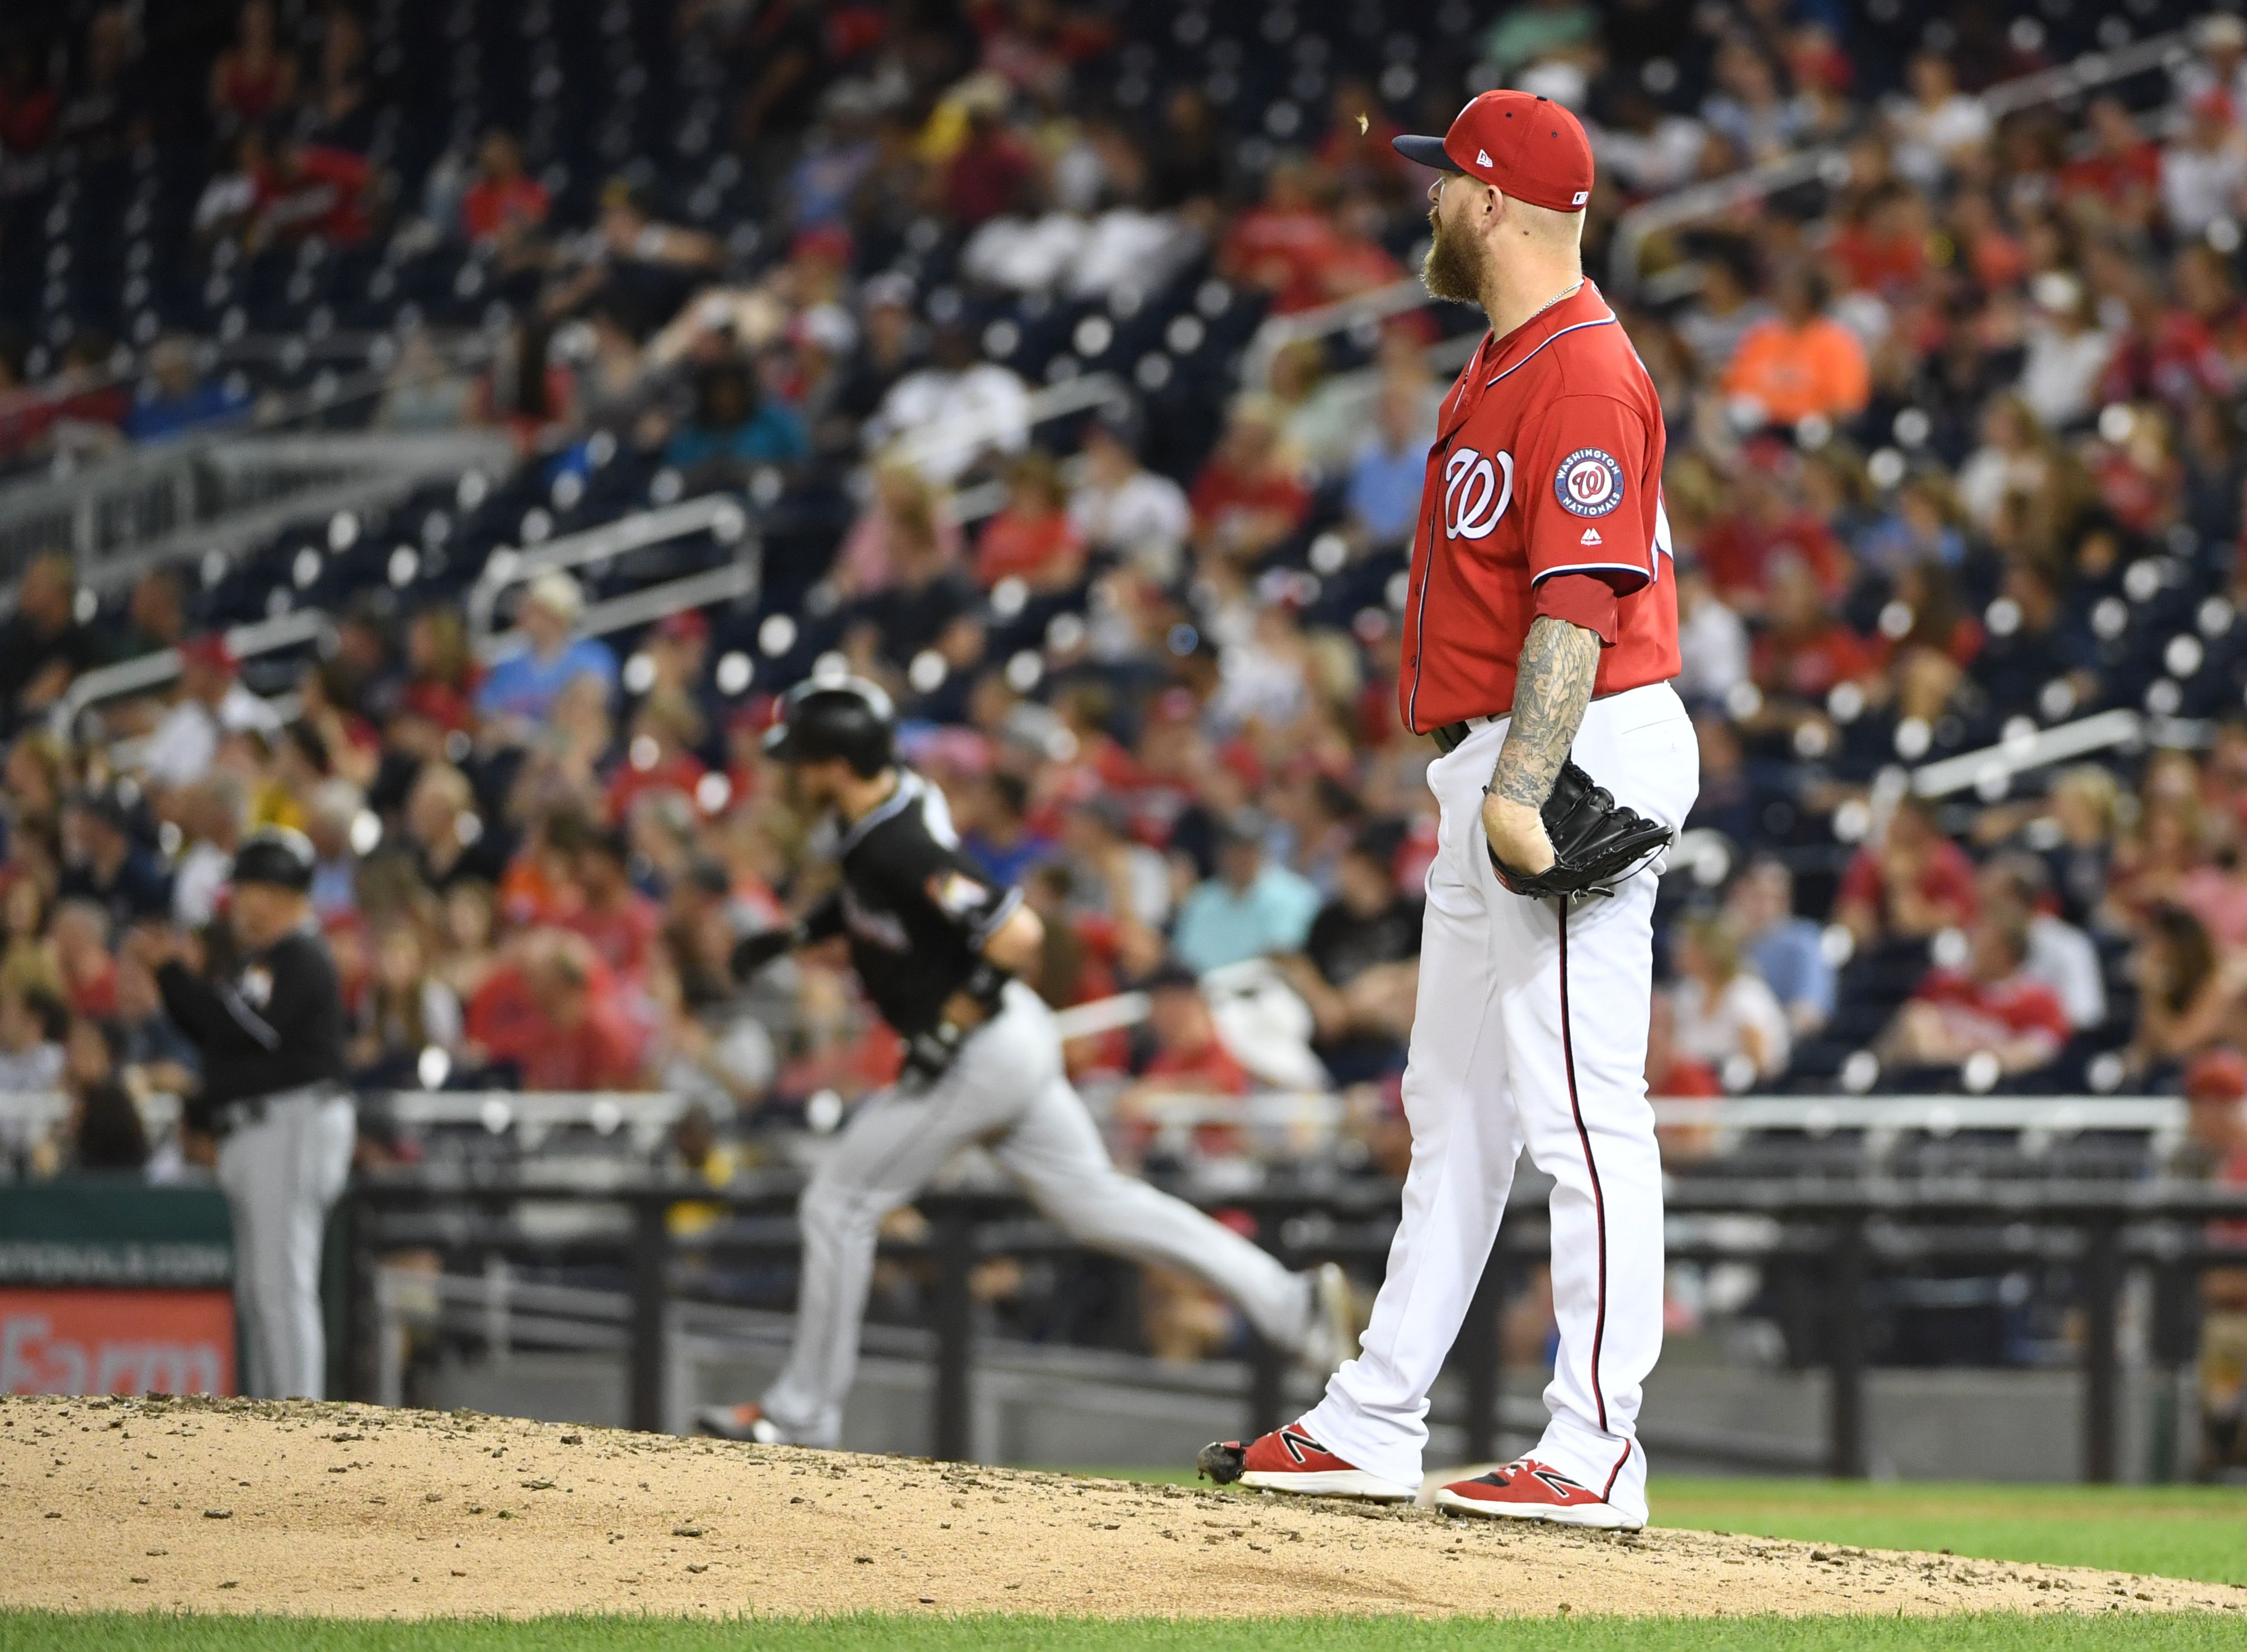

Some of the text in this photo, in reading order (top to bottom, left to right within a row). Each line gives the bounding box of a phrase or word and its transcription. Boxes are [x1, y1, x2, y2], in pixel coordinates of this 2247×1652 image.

[1557, 449, 1621, 479] WASHINGTON
[1445, 448, 1514, 540] W
[1572, 465, 1605, 499] W
[1563, 492, 1621, 515] NATIONALS
[3, 1314, 219, 1396] Farm
